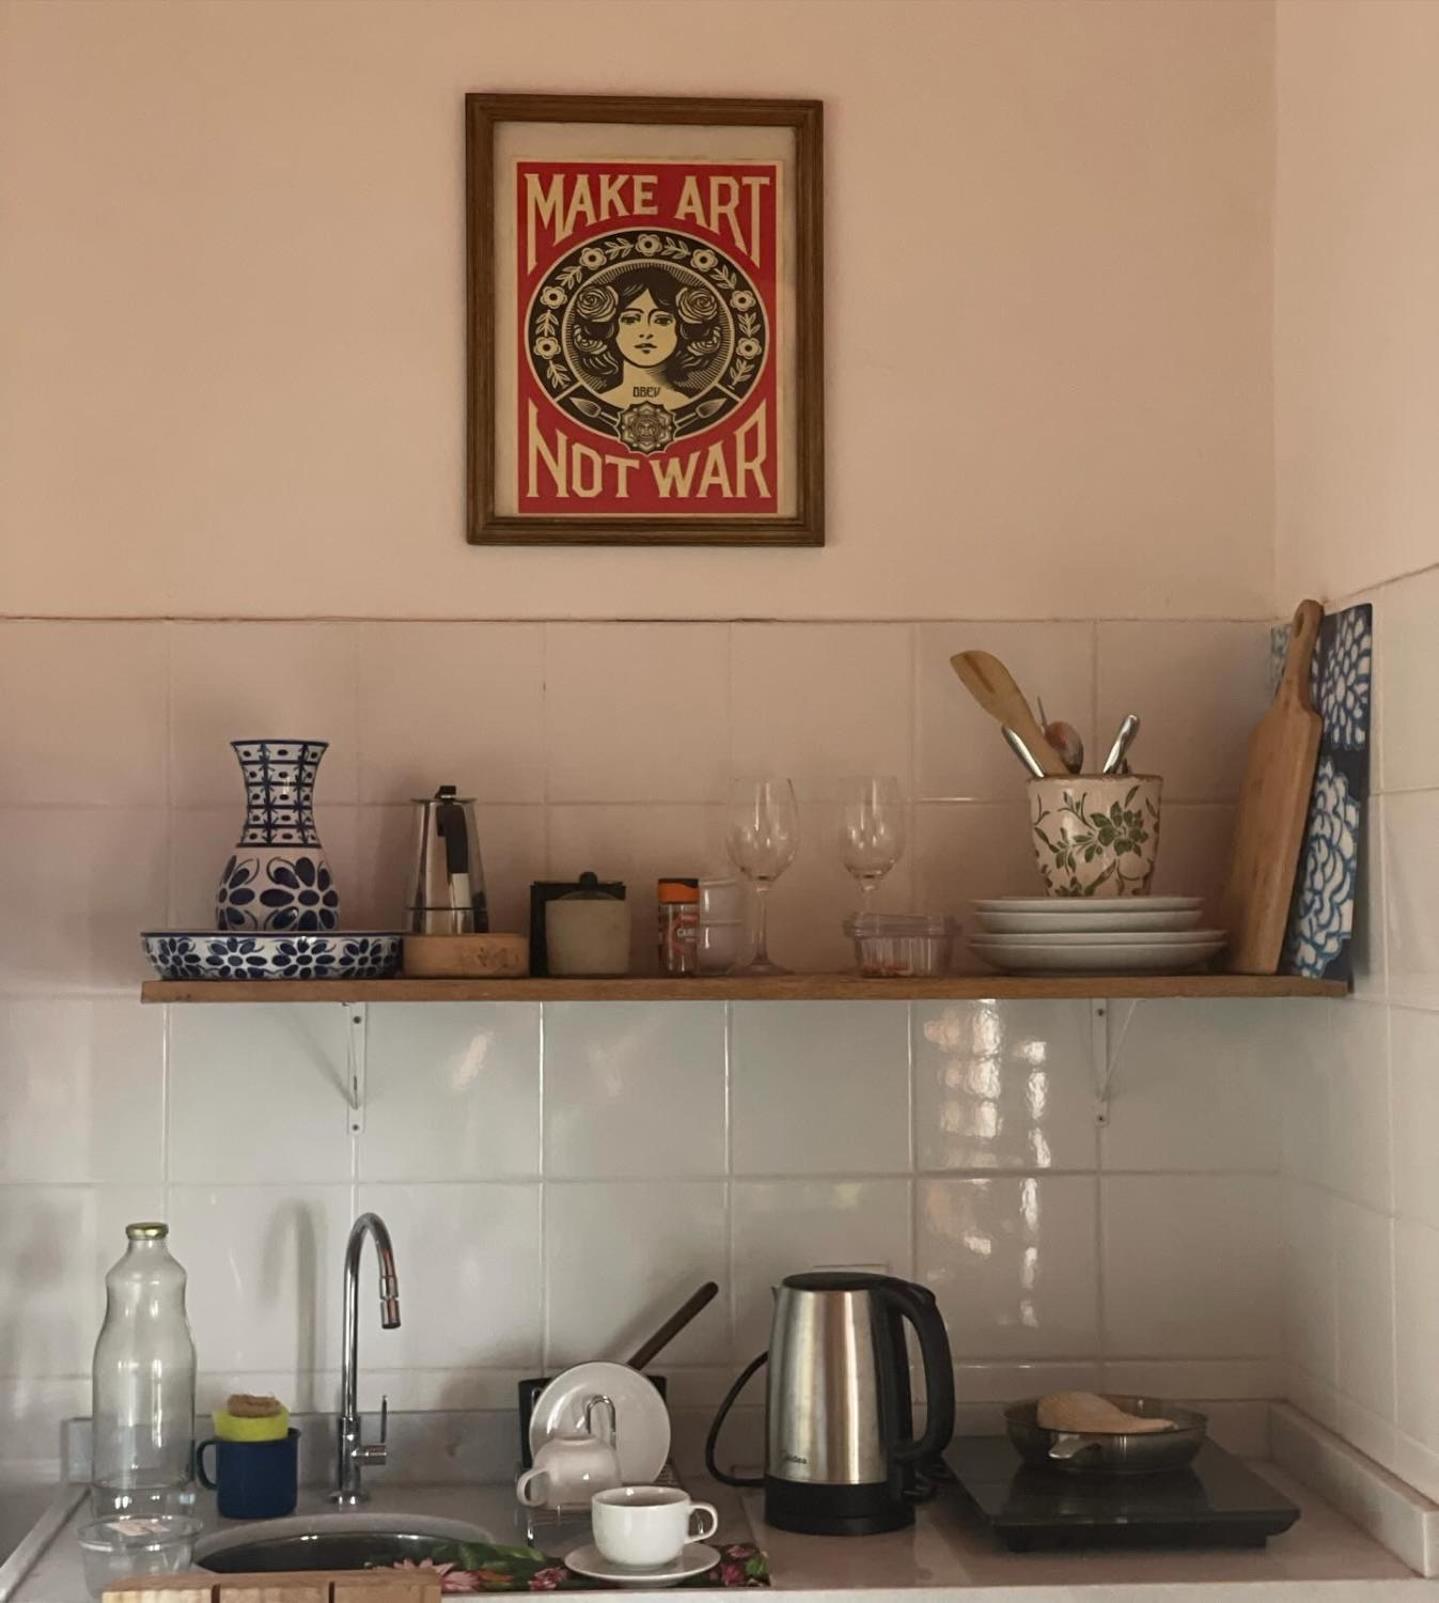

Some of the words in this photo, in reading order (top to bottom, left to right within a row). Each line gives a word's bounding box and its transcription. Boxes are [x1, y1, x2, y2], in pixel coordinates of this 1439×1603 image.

[524, 173, 658, 276] MAKE
[673, 175, 771, 270] ART
[526, 397, 640, 498] NOT
[649, 398, 772, 498] WAR
